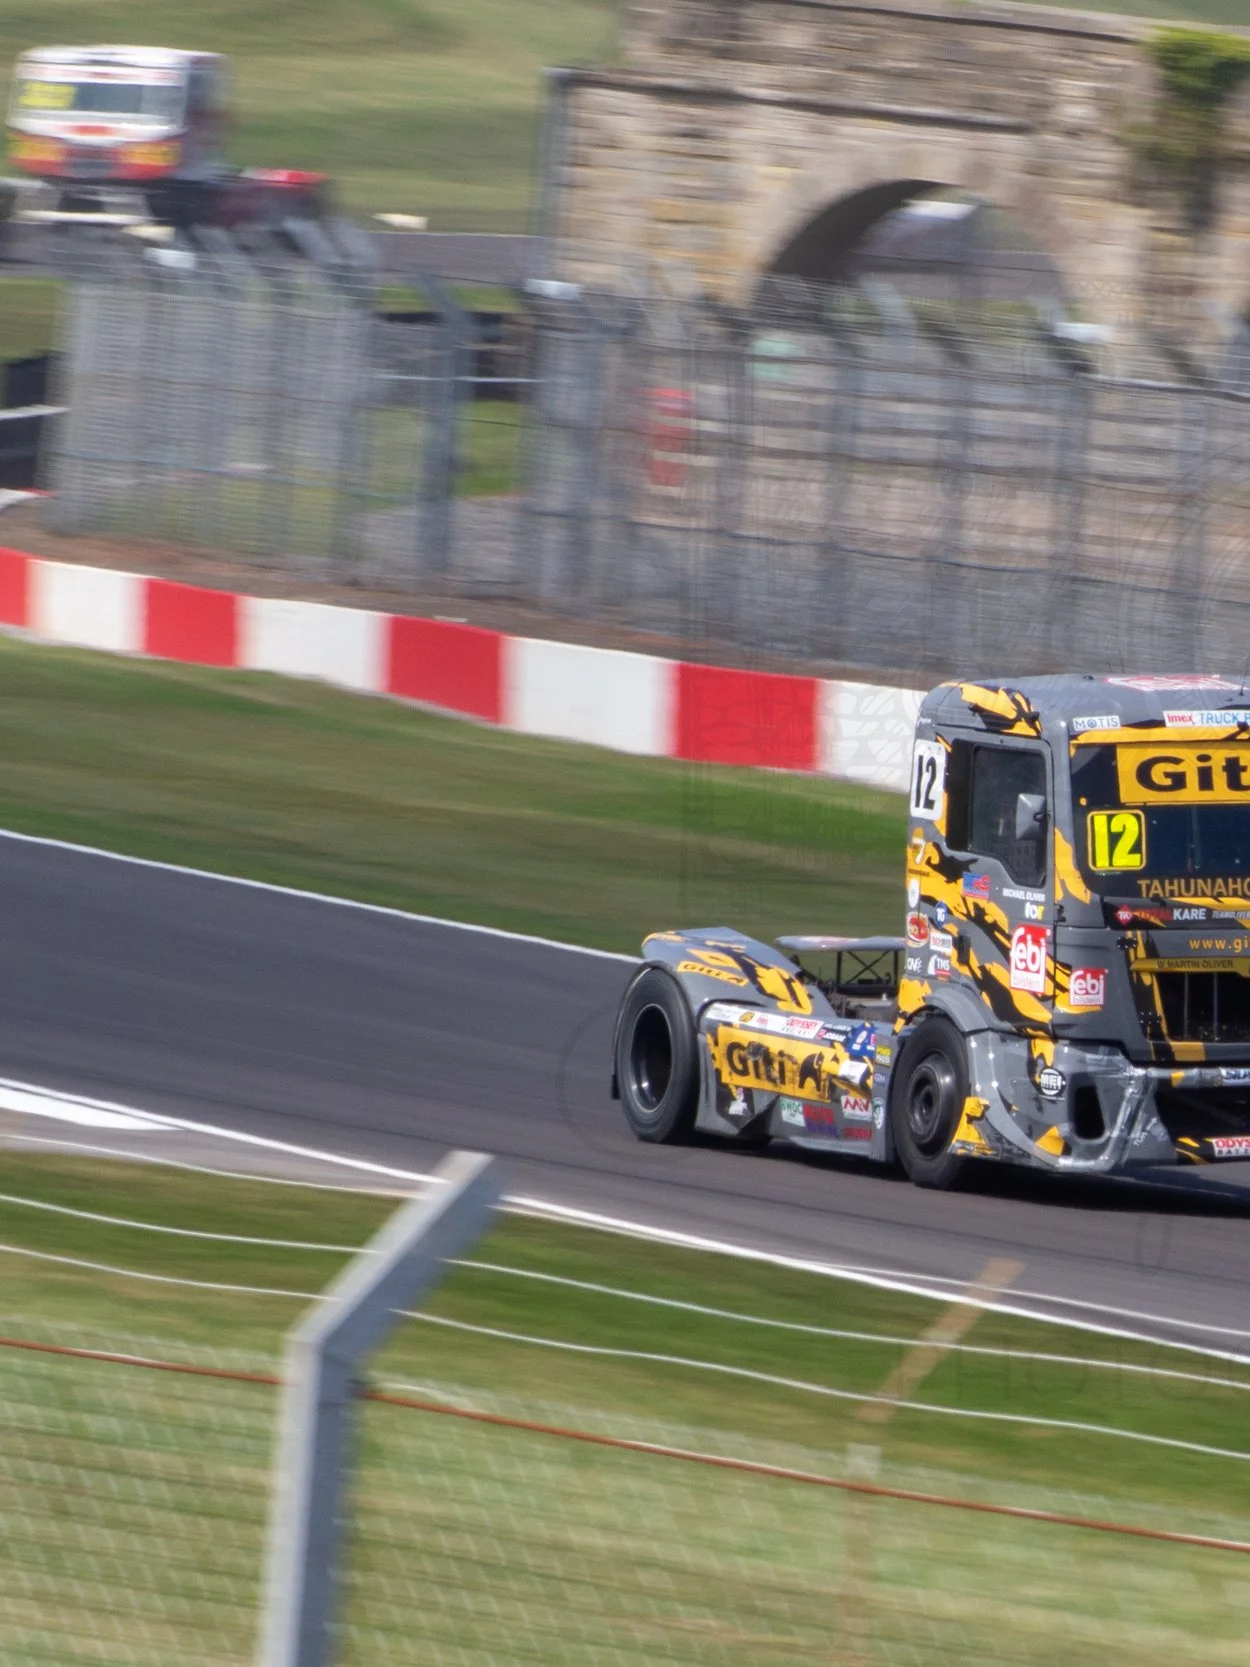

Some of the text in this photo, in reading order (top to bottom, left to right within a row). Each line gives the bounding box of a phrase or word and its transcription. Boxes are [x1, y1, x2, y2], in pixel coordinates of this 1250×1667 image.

[1167, 714, 1196, 725] imex
[1200, 712, 1239, 724] TRUCK
[914, 754, 937, 811] 12
[1093, 813, 1142, 869] 12
[1172, 908, 1207, 920] KARE
[1167, 960, 1200, 969] MARTIN
[1201, 960, 1234, 969] OLIVER
